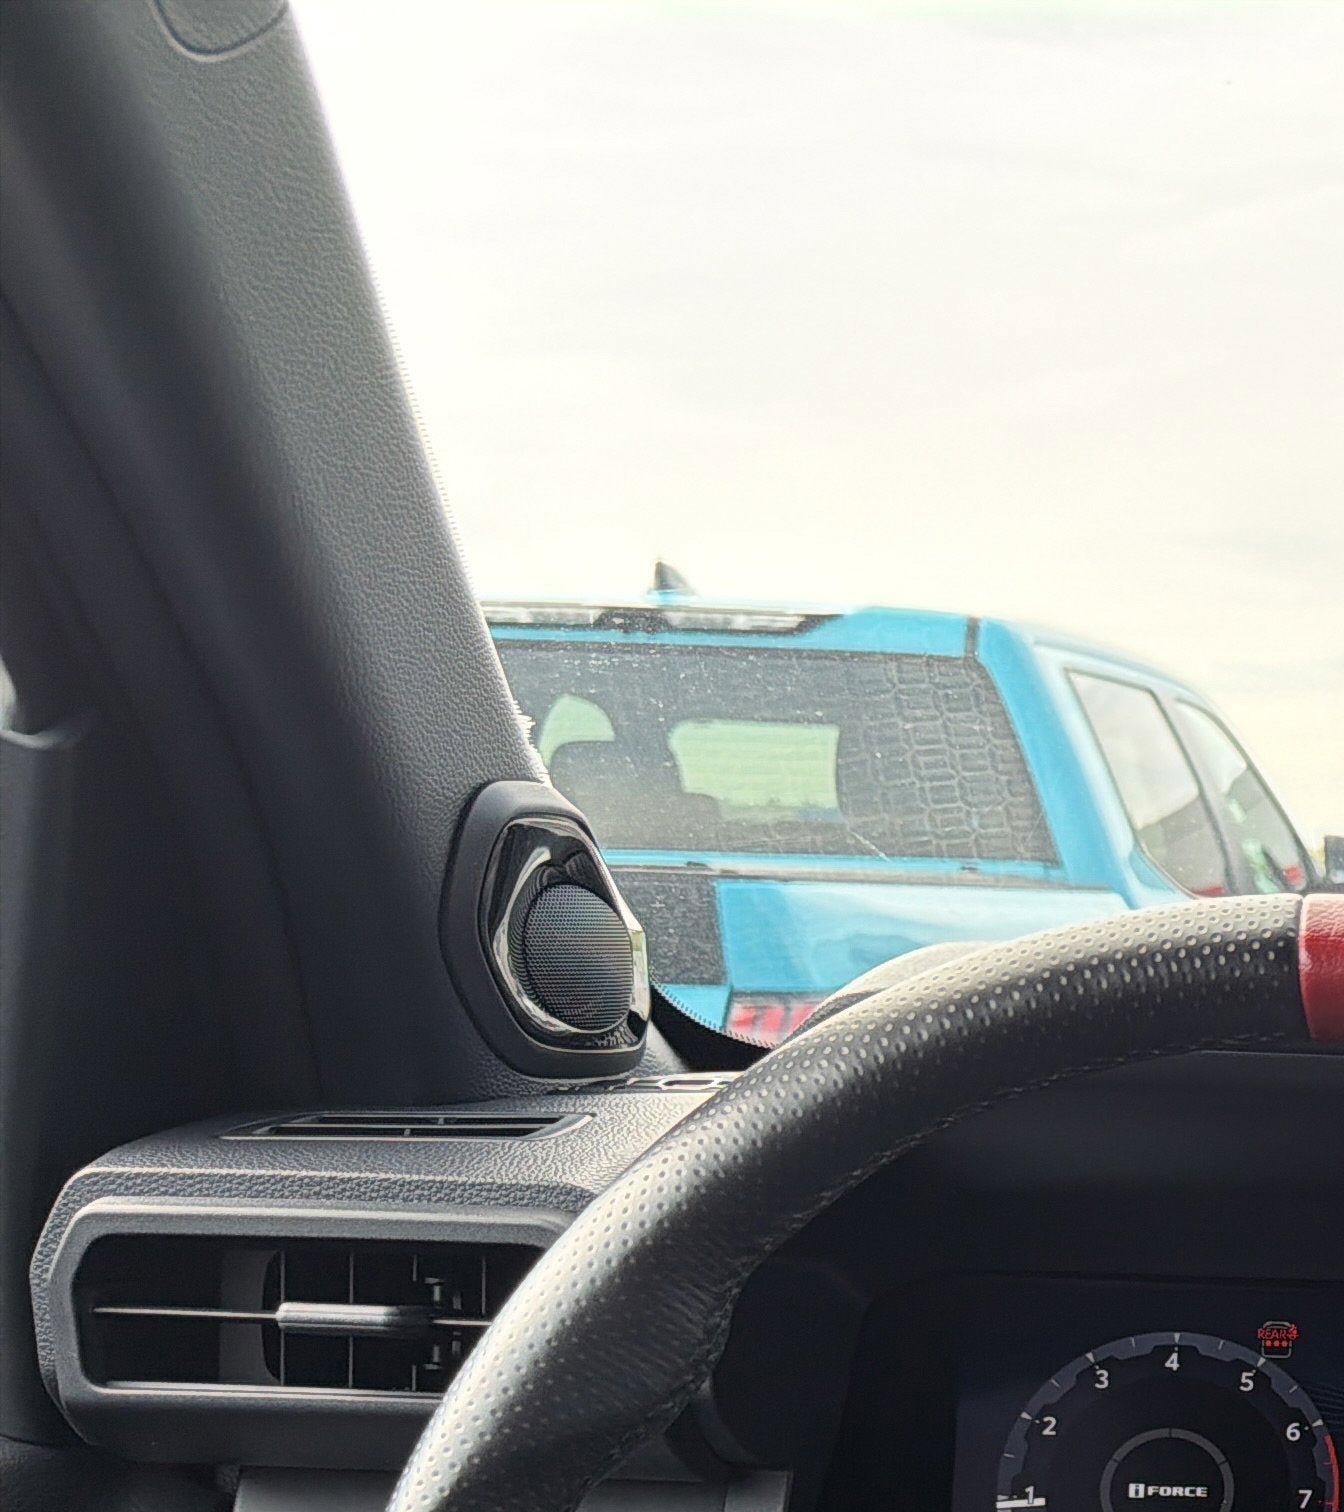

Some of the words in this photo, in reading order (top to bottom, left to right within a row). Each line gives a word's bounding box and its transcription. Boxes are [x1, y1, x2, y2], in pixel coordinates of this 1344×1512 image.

[1257, 1327, 1288, 1340] REAR
[1165, 1353, 1180, 1371] 4
[1094, 1370, 1109, 1389] 3
[1239, 1373, 1254, 1391] 5
[1041, 1416, 1057, 1436] 2
[1286, 1422, 1301, 1441] 6
[1024, 1485, 1035, 1505] 1
[1147, 1485, 1209, 1498] FORCE
[1299, 1490, 1313, 1508] 7
